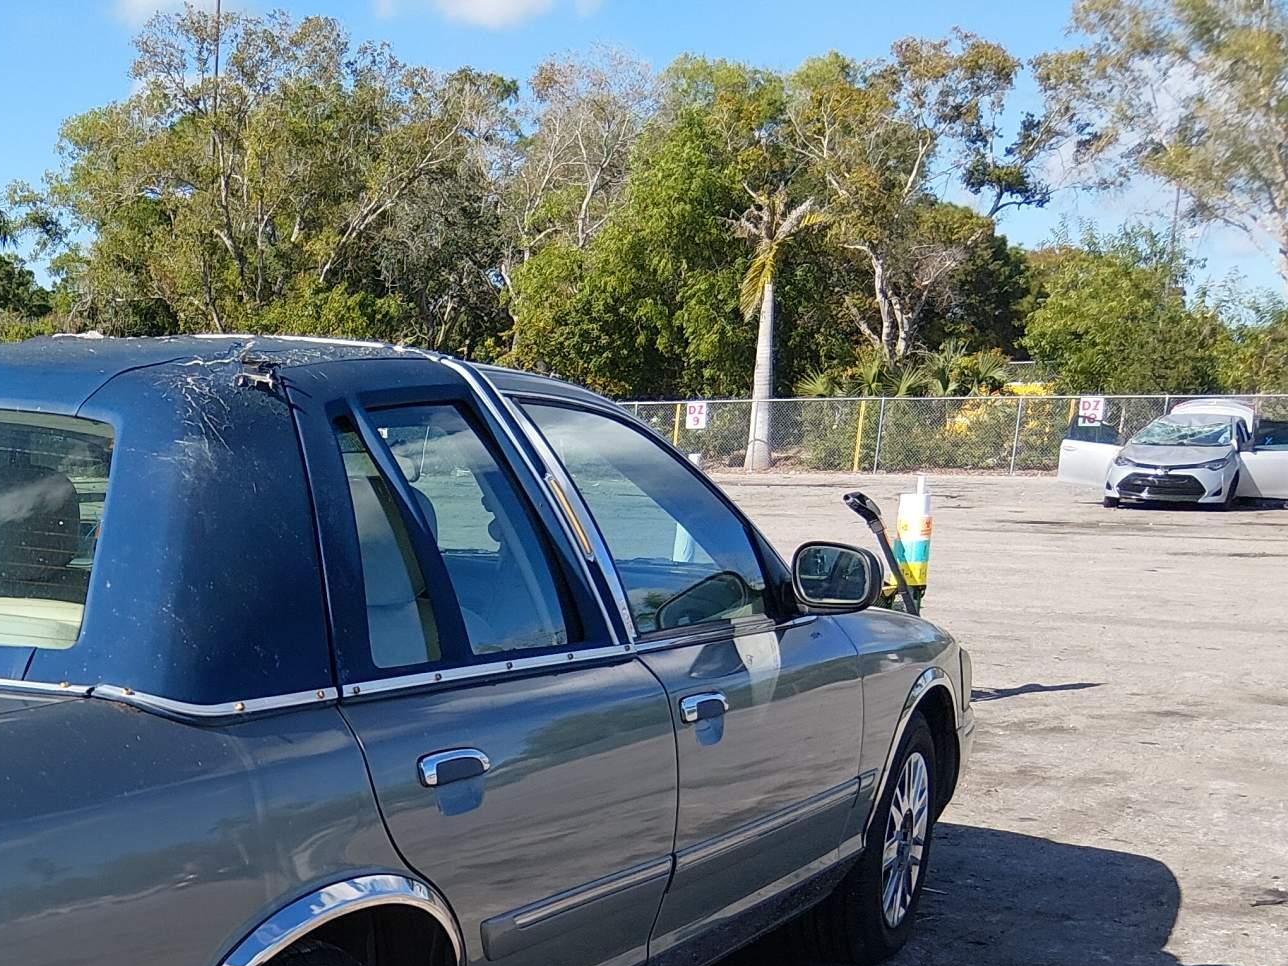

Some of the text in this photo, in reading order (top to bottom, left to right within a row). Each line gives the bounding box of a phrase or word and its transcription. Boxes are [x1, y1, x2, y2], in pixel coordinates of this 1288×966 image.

[688, 405, 704, 415] DZ
[1082, 399, 1101, 411] DZ
[692, 416, 700, 426] 9
